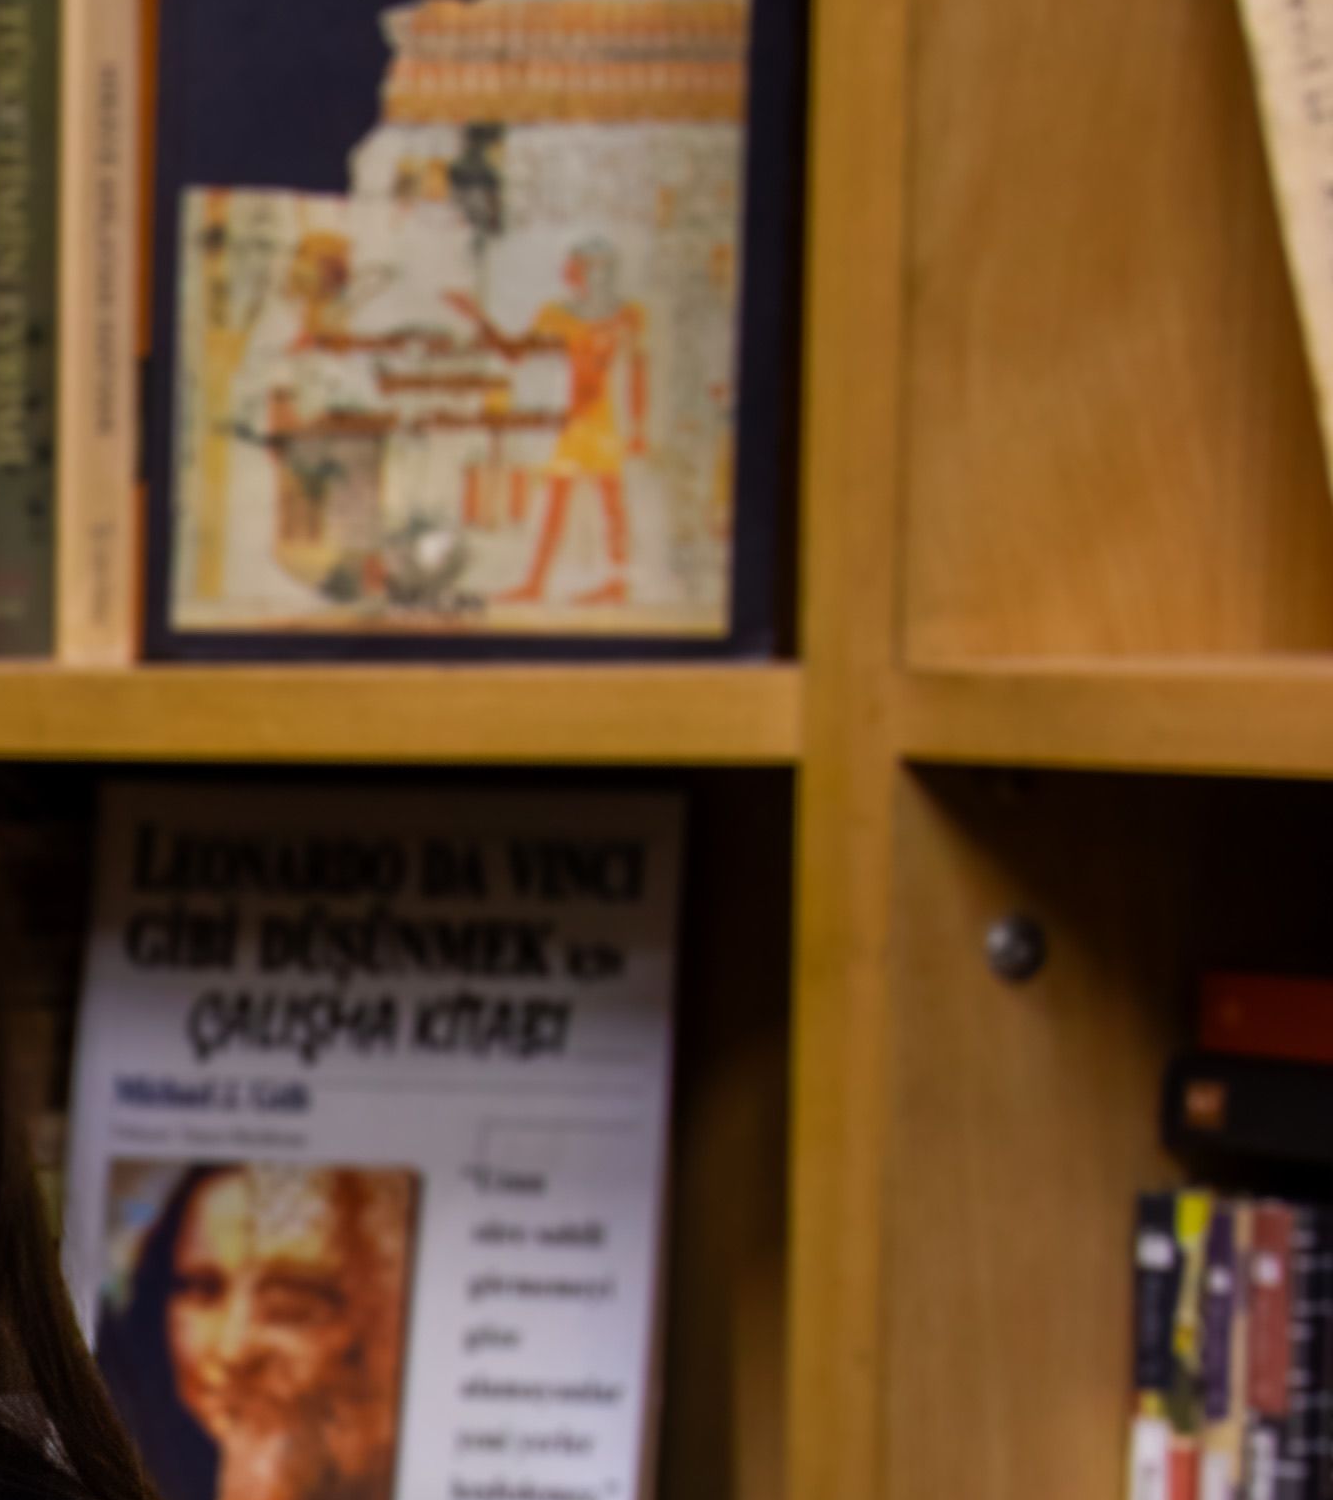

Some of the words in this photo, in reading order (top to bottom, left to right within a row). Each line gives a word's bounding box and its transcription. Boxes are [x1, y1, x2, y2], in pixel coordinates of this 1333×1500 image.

[253, 908, 549, 995] DÜŞÜNMEK
[188, 996, 403, 1070] ÇALIŞMA
[412, 994, 574, 1059] KİTABI
